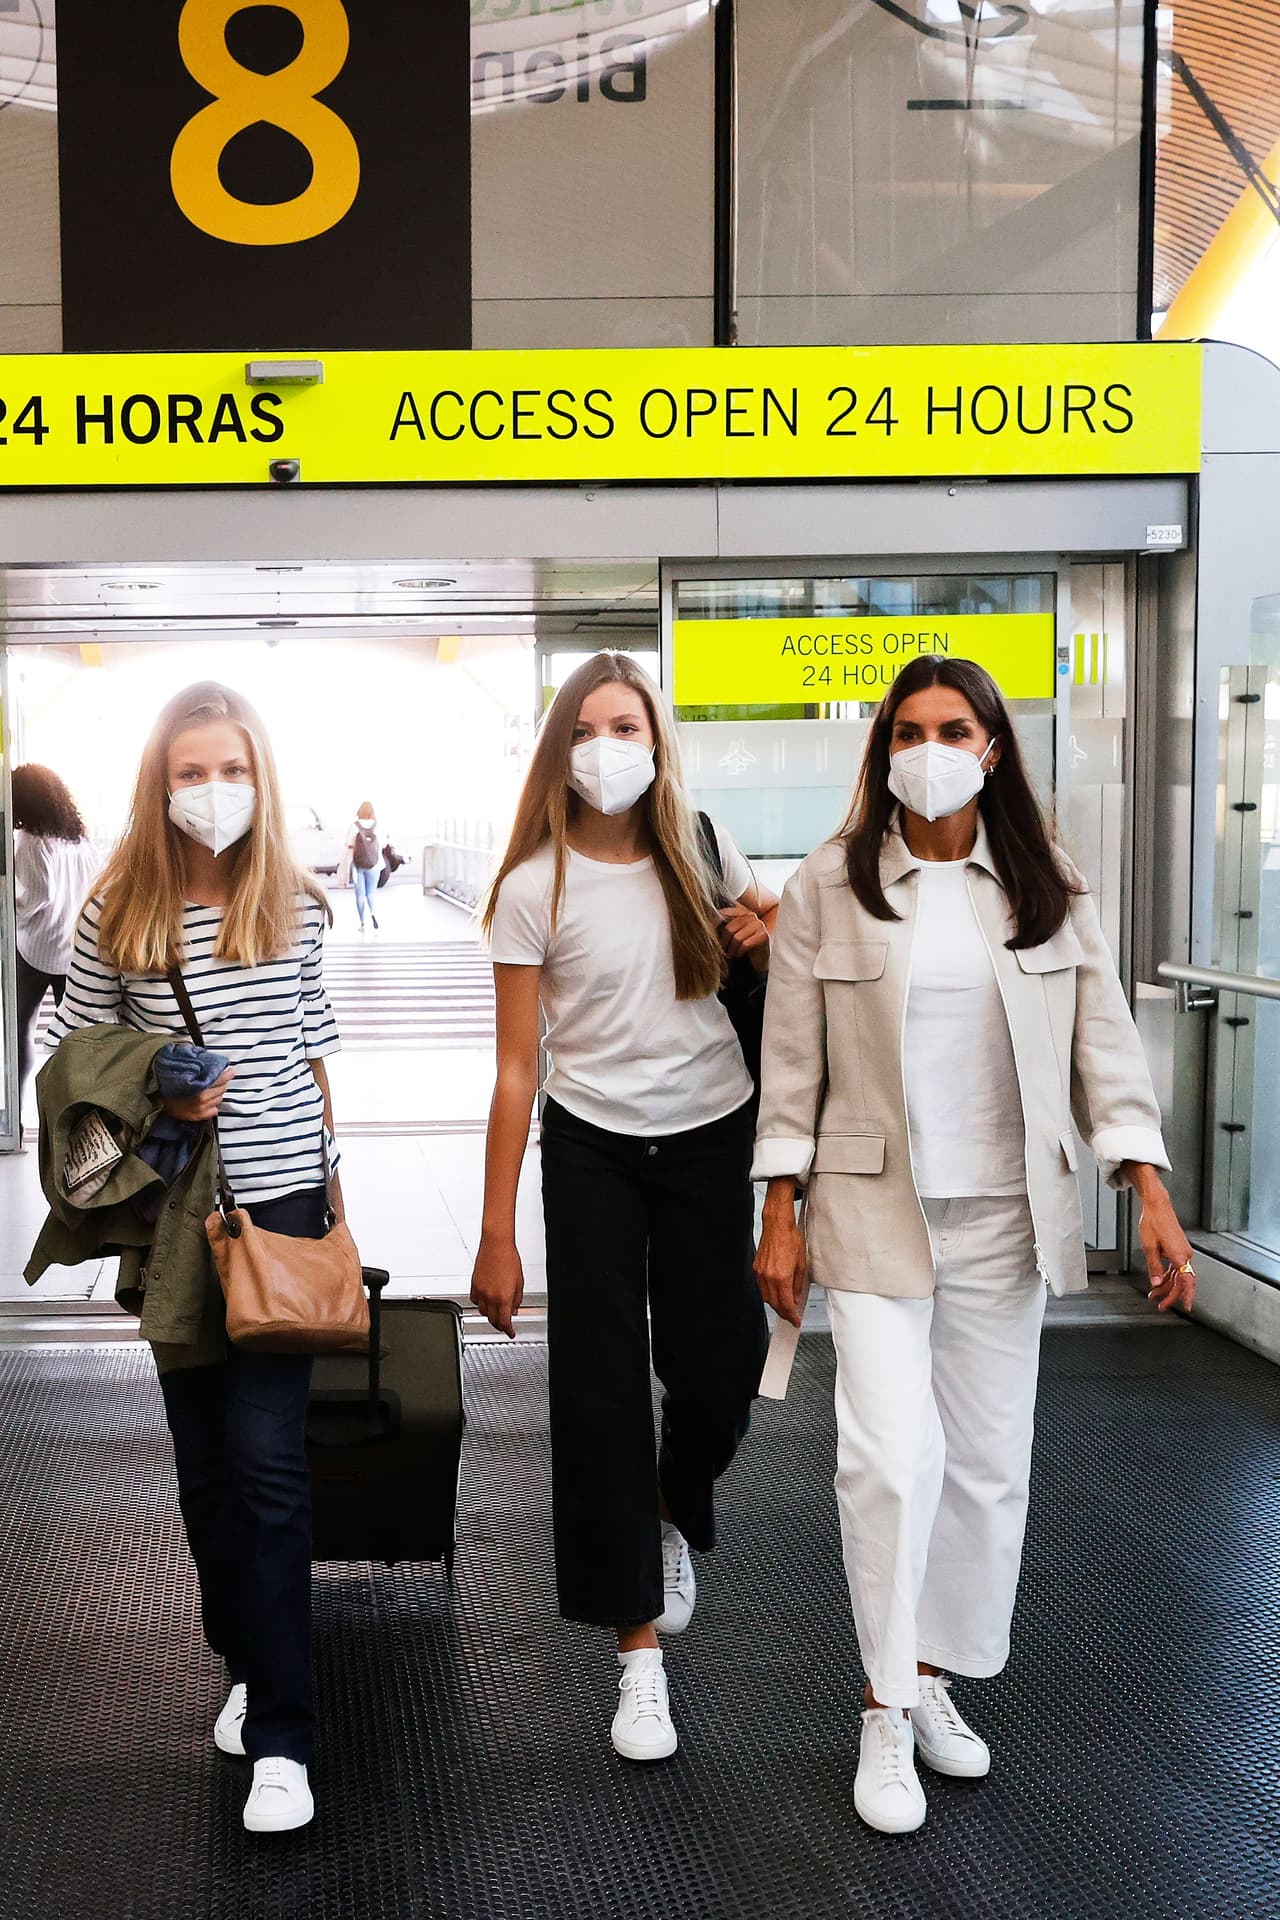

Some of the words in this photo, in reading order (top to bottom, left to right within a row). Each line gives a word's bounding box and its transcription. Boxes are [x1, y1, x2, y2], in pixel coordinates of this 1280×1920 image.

[170, 0, 361, 246] 8
[0, 395, 50, 446] 4
[75, 391, 285, 445] HORAS
[389, 389, 615, 441] ACCESS
[639, 387, 798, 439] OPEN
[826, 386, 899, 437] 24
[927, 383, 1133, 435] HOURS
[781, 633, 874, 656] ACCESS
[882, 632, 949, 655] OPEN
[802, 664, 833, 687] 24
[843, 663, 900, 686] HOU
